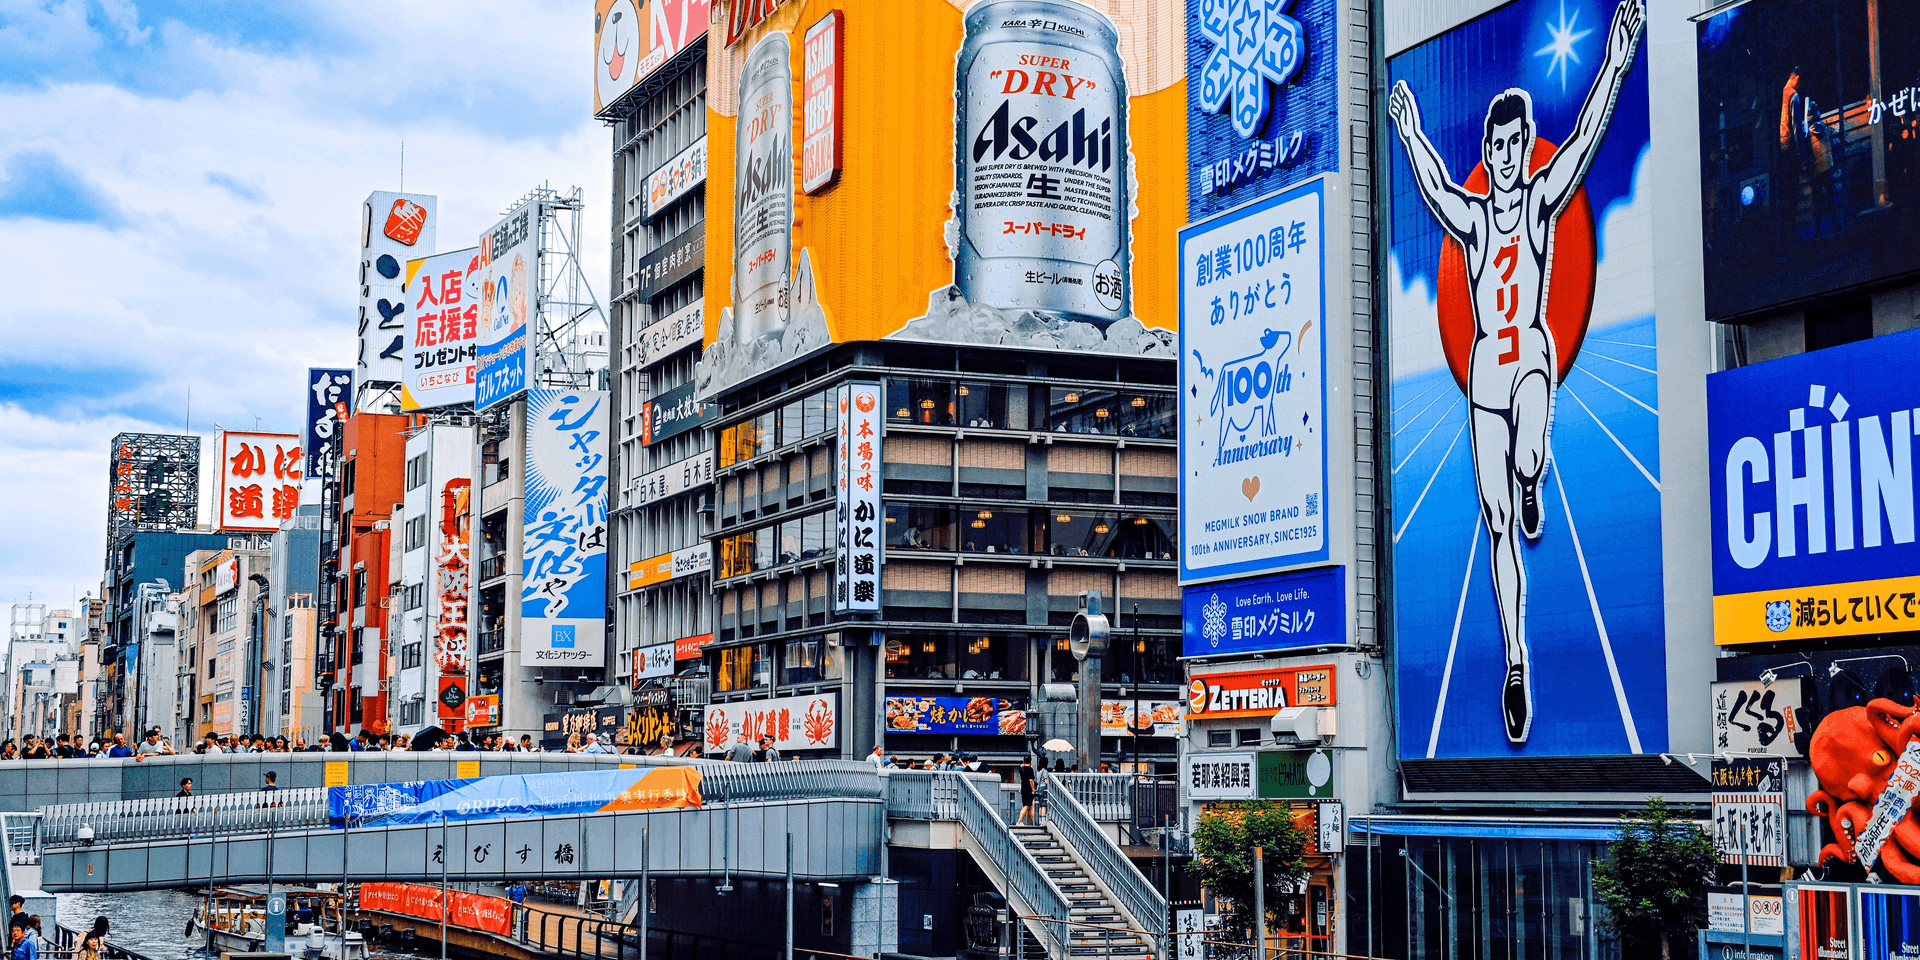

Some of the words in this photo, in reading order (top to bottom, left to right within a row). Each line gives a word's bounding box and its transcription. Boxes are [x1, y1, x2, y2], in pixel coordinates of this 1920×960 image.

[1028, 19, 1057, 31] 辛口
[1057, 24, 1085, 36] KUCHI
[805, 26, 834, 83] ASAHI
[1019, 54, 1070, 71] SUPER
[756, 92, 774, 111] SUPER
[804, 84, 833, 138] 1889
[973, 99, 1111, 174] Asahi
[804, 132, 832, 185] OSAKA
[1023, 163, 1047, 171] BREWED
[1065, 168, 1093, 179] PRECISION
[1200, 130, 1303, 196] 雪印メグミルク
[740, 132, 786, 216] Asahi
[1026, 173, 1062, 201] 生
[1064, 177, 1085, 186] UNDER
[1085, 181, 1096, 189] THE
[1064, 186, 1089, 196] MASTER
[1064, 195, 1077, 203] ING
[1077, 197, 1111, 212] TECHNIQUES
[757, 207, 768, 234] 生
[1079, 207, 1097, 216] CLEAN
[1003, 221, 1086, 241] スーパードライ
[1196, 220, 1307, 287] 創業100周年
[416, 269, 463, 310] 入店
[641, 264, 652, 290] 7F
[1210, 272, 1292, 326] ありがとう
[1493, 234, 1520, 366] グリコ
[478, 357, 523, 403] ガルフネット
[1227, 360, 1292, 407] 100th
[230, 443, 303, 480] かに
[856, 418, 874, 492] 本場の味
[1212, 435, 1293, 467] Anniversary
[684, 457, 711, 488] 白木屋
[640, 474, 665, 504] 白木屋
[1726, 407, 1920, 569] CHIN
[1205, 516, 1240, 533] MEGMILK
[1243, 511, 1267, 527] SNOW
[1270, 506, 1299, 522] BRAND
[1191, 543, 1211, 556] 100th
[437, 537, 469, 666] 大阪王将
[1236, 596, 1252, 608] Love
[1252, 593, 1274, 606] Earth.
[1276, 591, 1293, 603] Love
[1294, 588, 1310, 600] Life.
[1796, 592, 1920, 628] 減らしていくで
[555, 631, 572, 642] BX
[1231, 609, 1315, 641] 雪印メグミルク
[1208, 685, 1286, 711] ZETTERIA
[1308, 694, 1327, 702] コーヒー
[930, 705, 977, 725] 焼かに
[1716, 690, 1728, 748] 道頓堀
[1728, 690, 1784, 747] くくる
[1713, 765, 1761, 787] 大阪もんを食す
[1767, 761, 1780, 777] くくる
[1771, 778, 1781, 791] 2F
[431, 843, 574, 865] えびす橋
[1829, 937, 1846, 949] Street
[1902, 942, 1919, 954] Street
